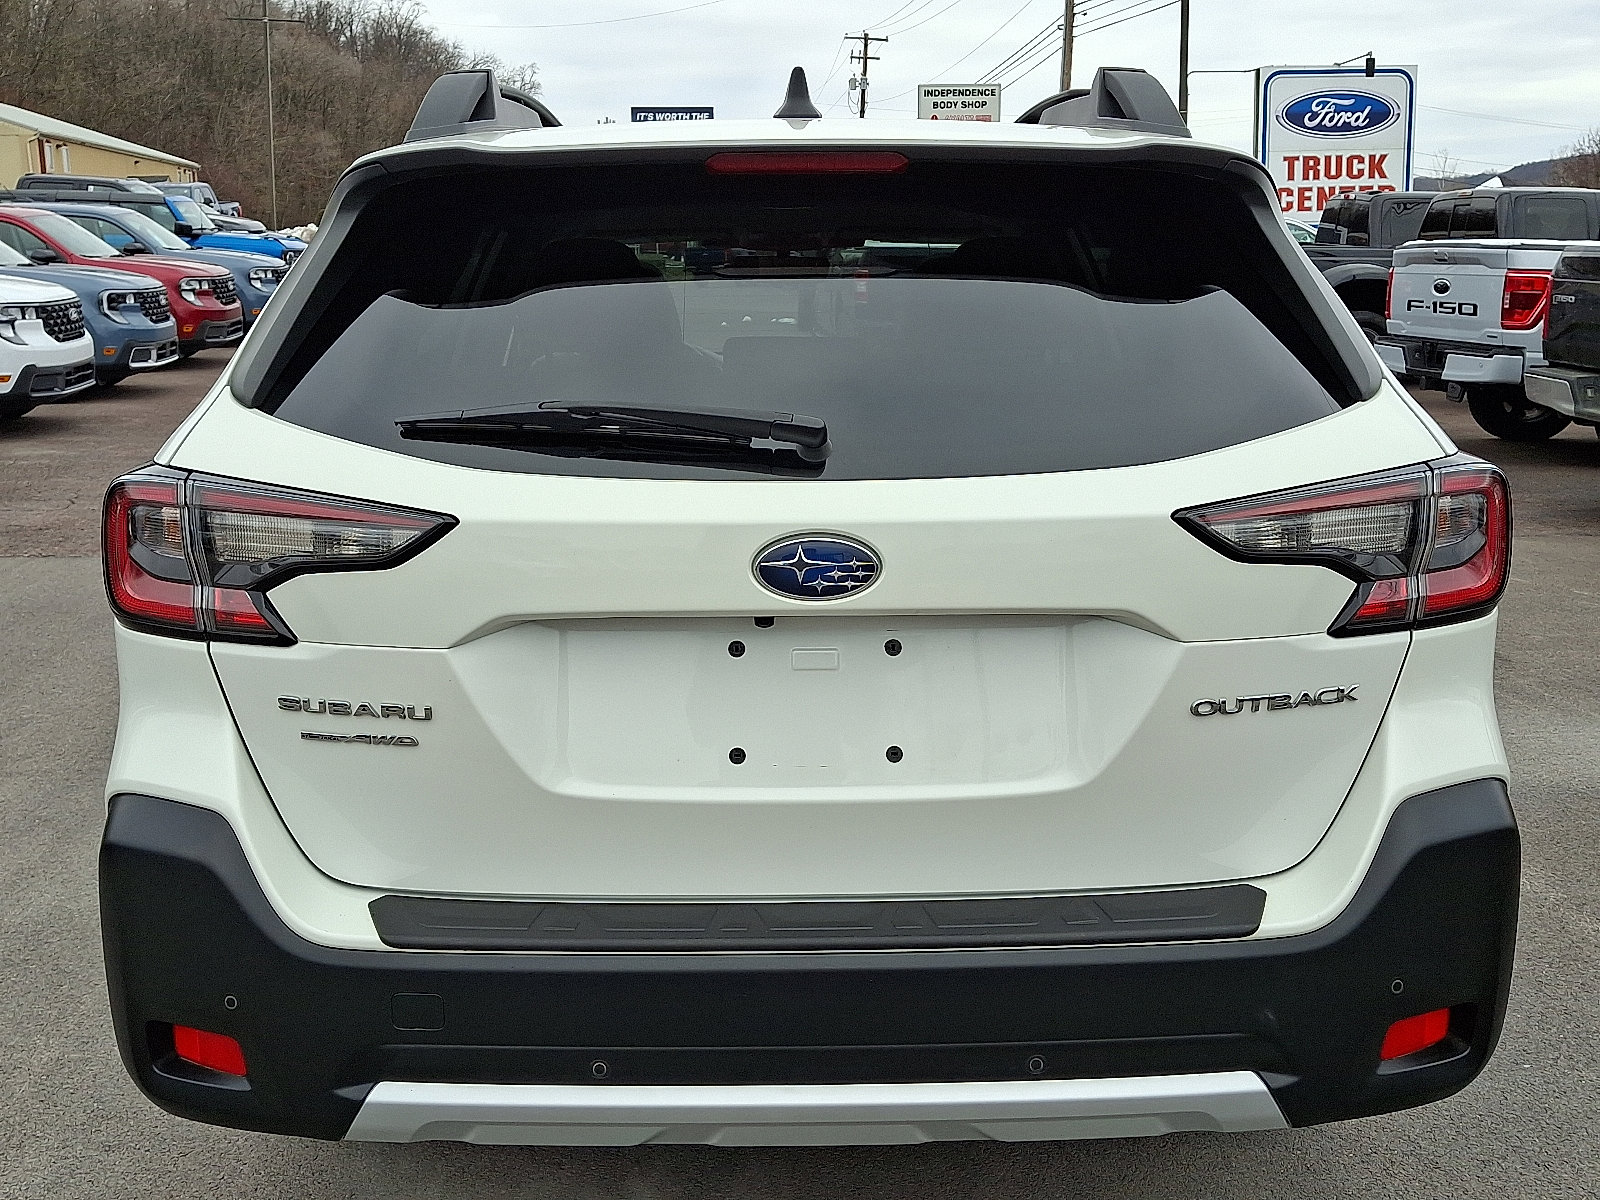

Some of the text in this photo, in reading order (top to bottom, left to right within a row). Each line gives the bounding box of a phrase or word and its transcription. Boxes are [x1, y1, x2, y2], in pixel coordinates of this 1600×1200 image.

[923, 88, 997, 98] INDEPENDENCE
[932, 100, 988, 110] BODY SHOP
[1303, 97, 1372, 128] Ford
[636, 112, 654, 121] IT'S
[655, 112, 690, 121] WORTH
[1282, 153, 1389, 182] TRUCK
[1406, 299, 1479, 317] F-150
[277, 695, 433, 721] SUBARU
[1189, 683, 1360, 717] OUTBACK
[346, 732, 420, 747] AWD
